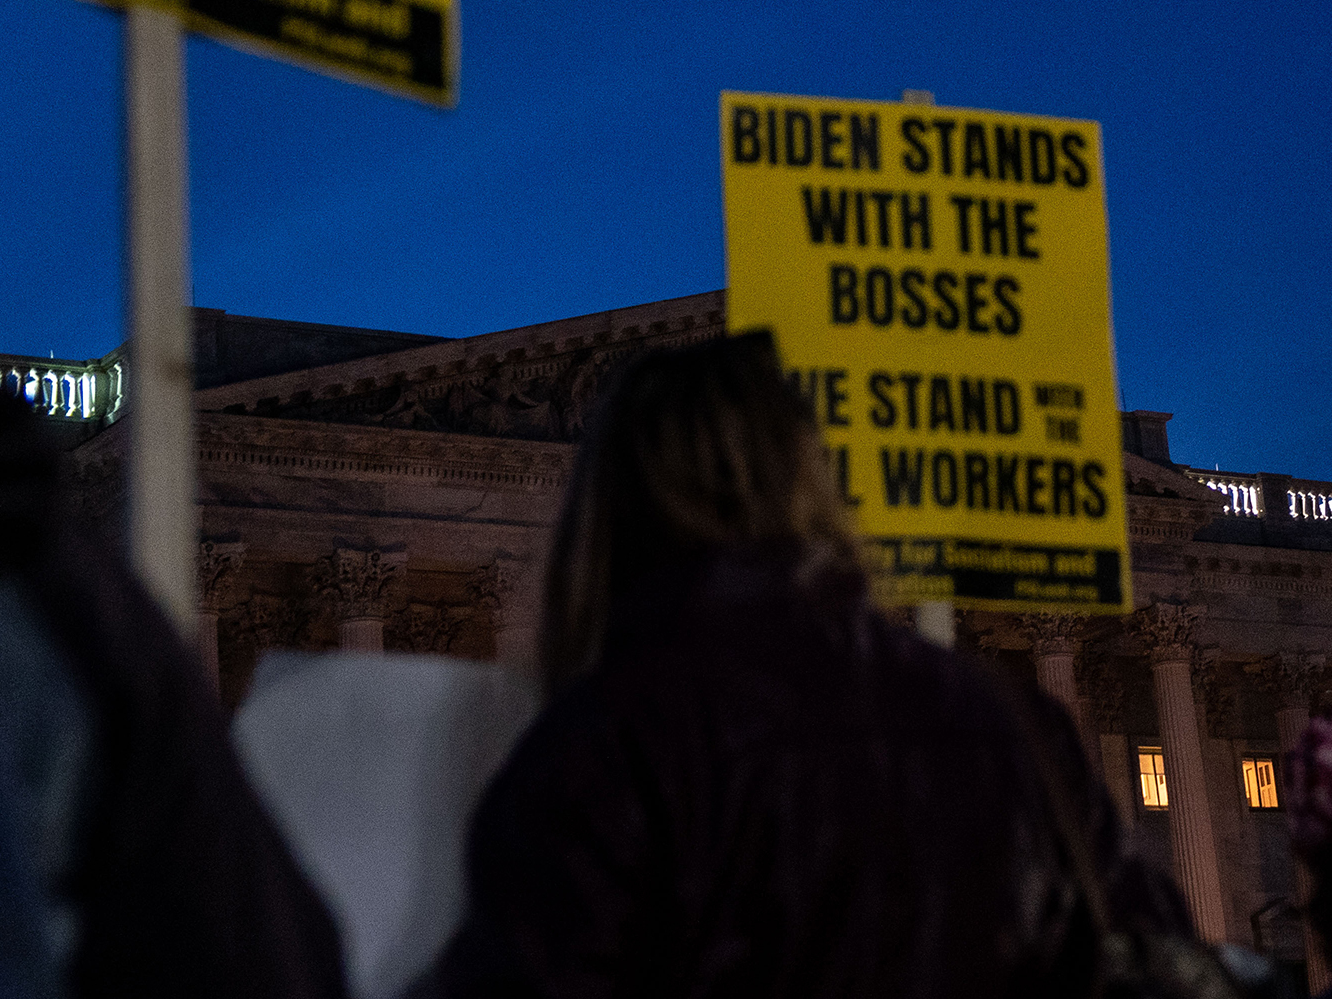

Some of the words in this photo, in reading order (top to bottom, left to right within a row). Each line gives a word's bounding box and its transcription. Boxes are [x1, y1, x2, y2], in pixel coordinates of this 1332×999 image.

[732, 105, 883, 173] BIDEN
[902, 116, 1091, 190] STANDS
[801, 185, 933, 252] WITH
[949, 194, 1042, 261] THE
[828, 261, 1022, 337] BOSSES
[867, 369, 1023, 437] STAND
[880, 444, 1109, 520] WORKERS
